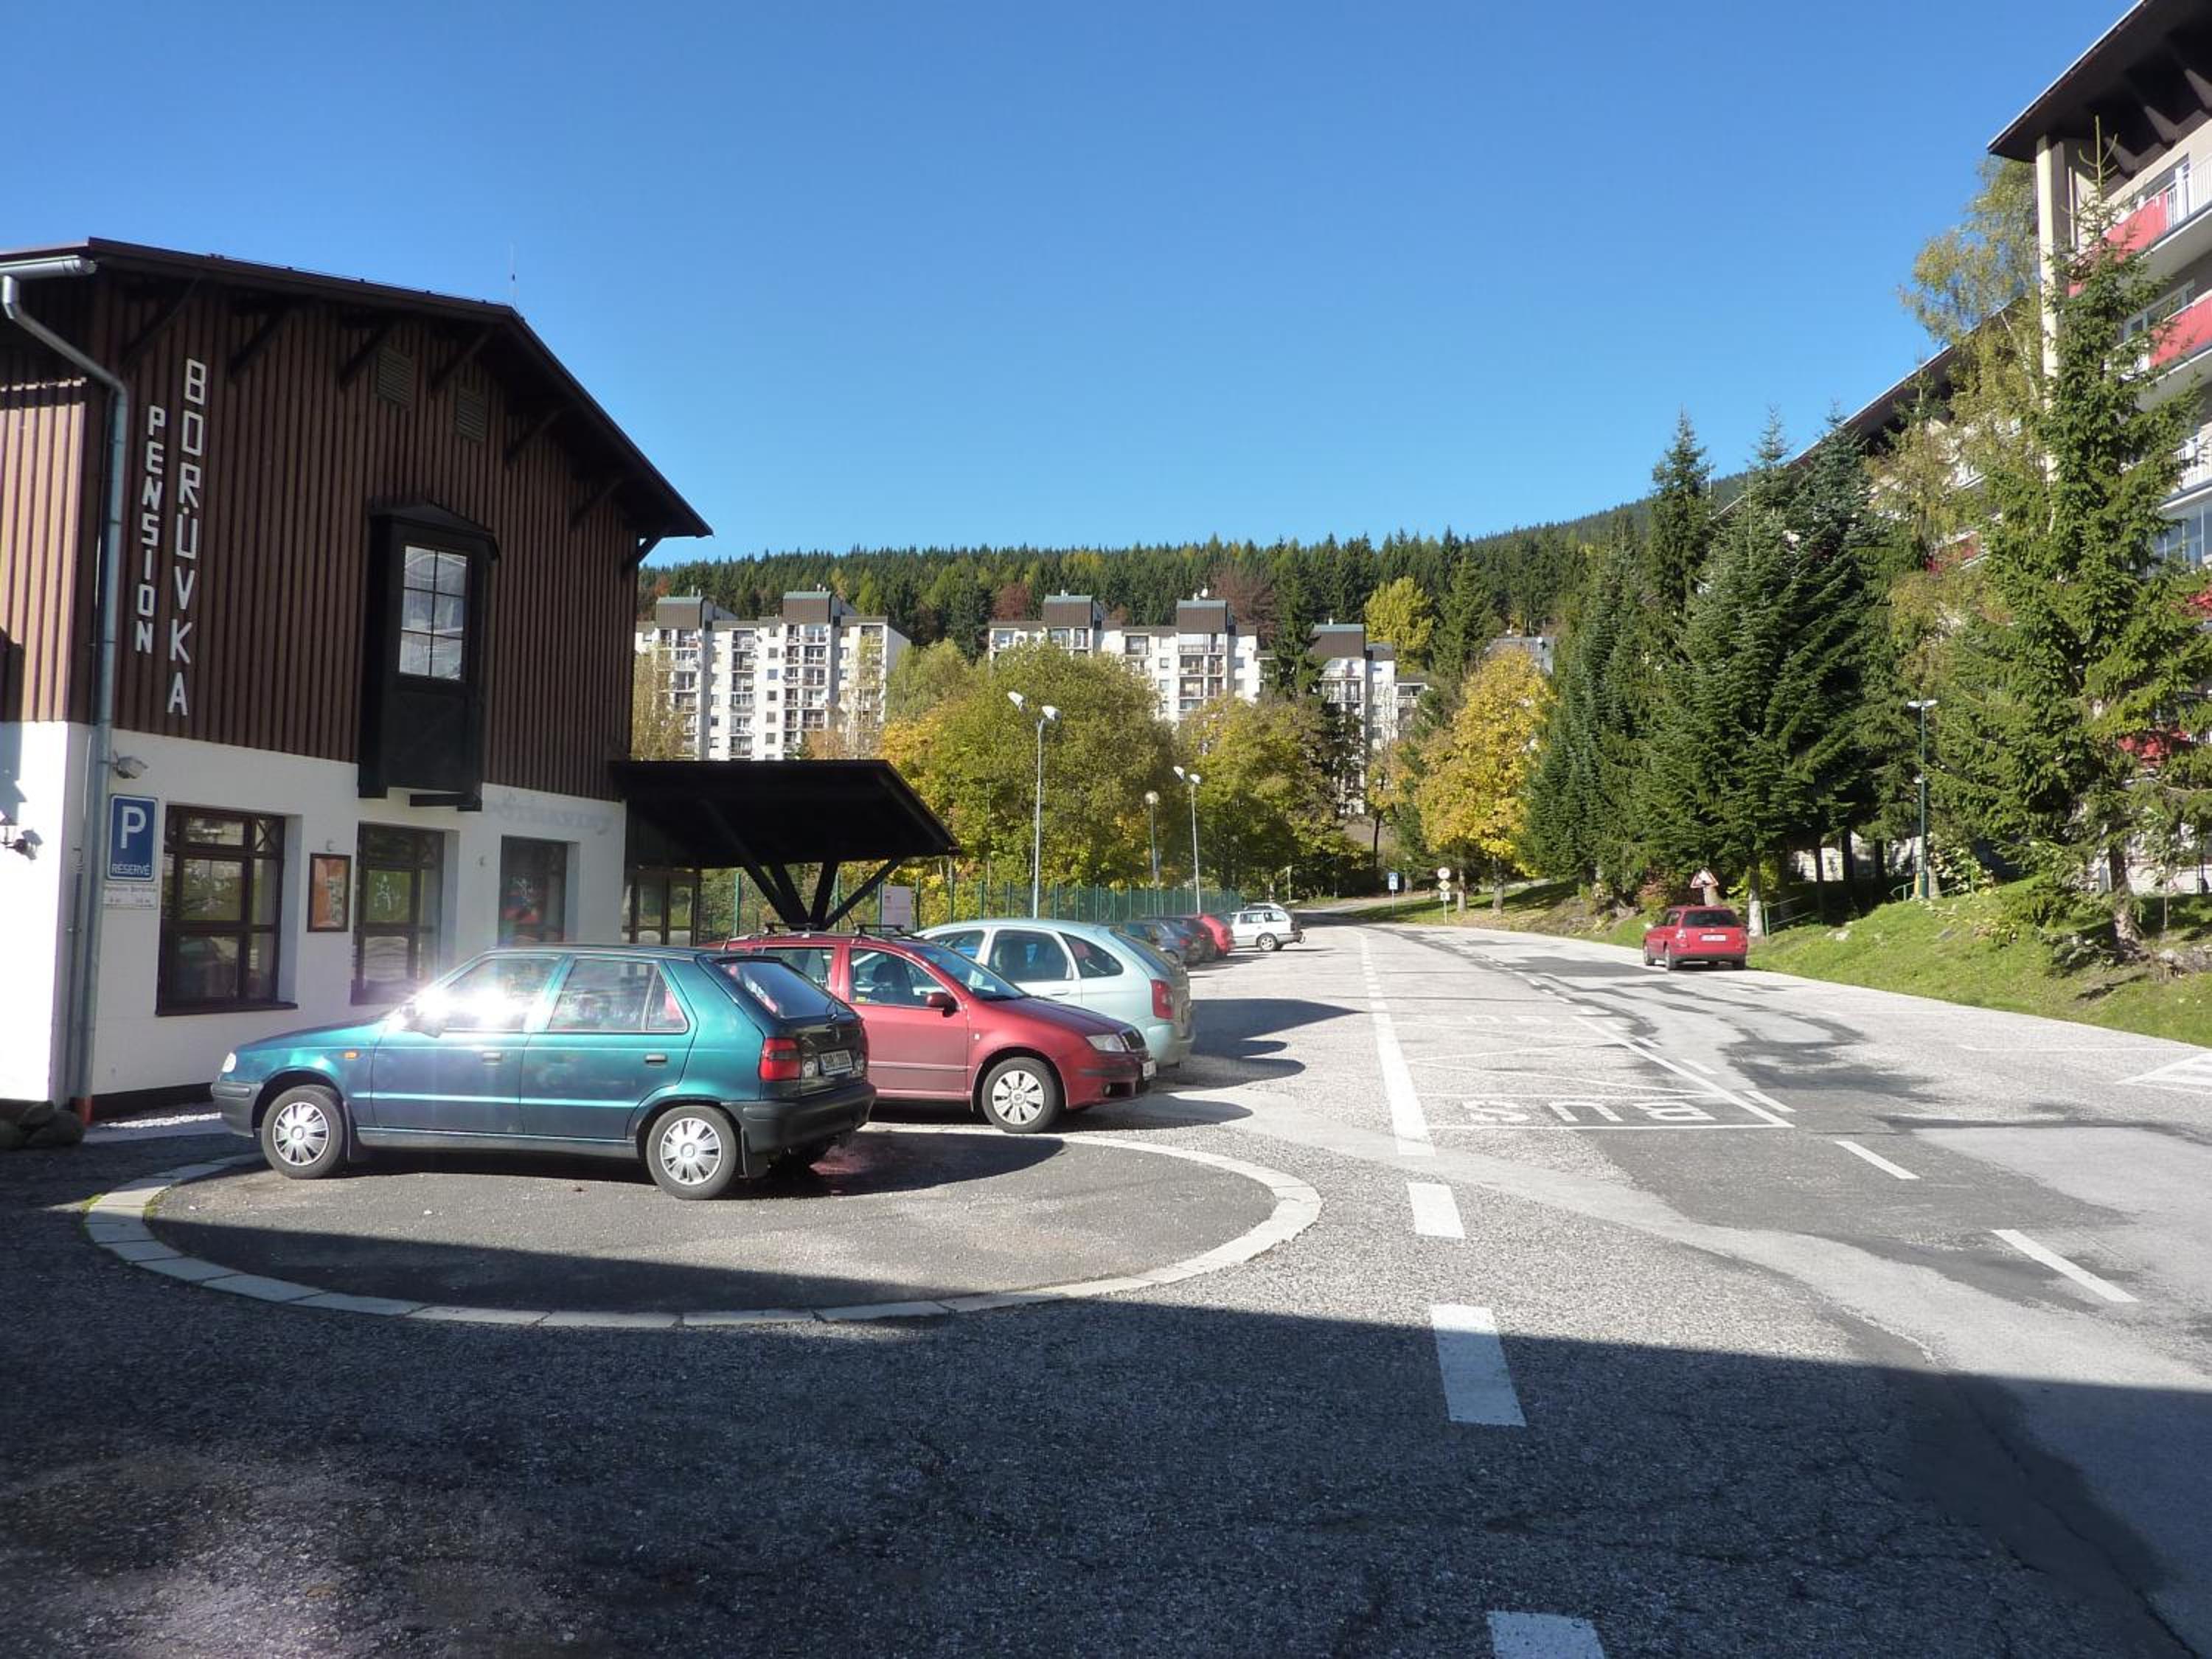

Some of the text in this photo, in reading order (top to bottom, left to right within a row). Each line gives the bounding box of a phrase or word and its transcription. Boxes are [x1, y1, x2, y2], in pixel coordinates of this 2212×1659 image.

[136, 405, 166, 654] PENSION
[167, 358, 206, 716] BORŮVKA
[120, 805, 147, 849] P
[1462, 1101, 1716, 1122] BUS
